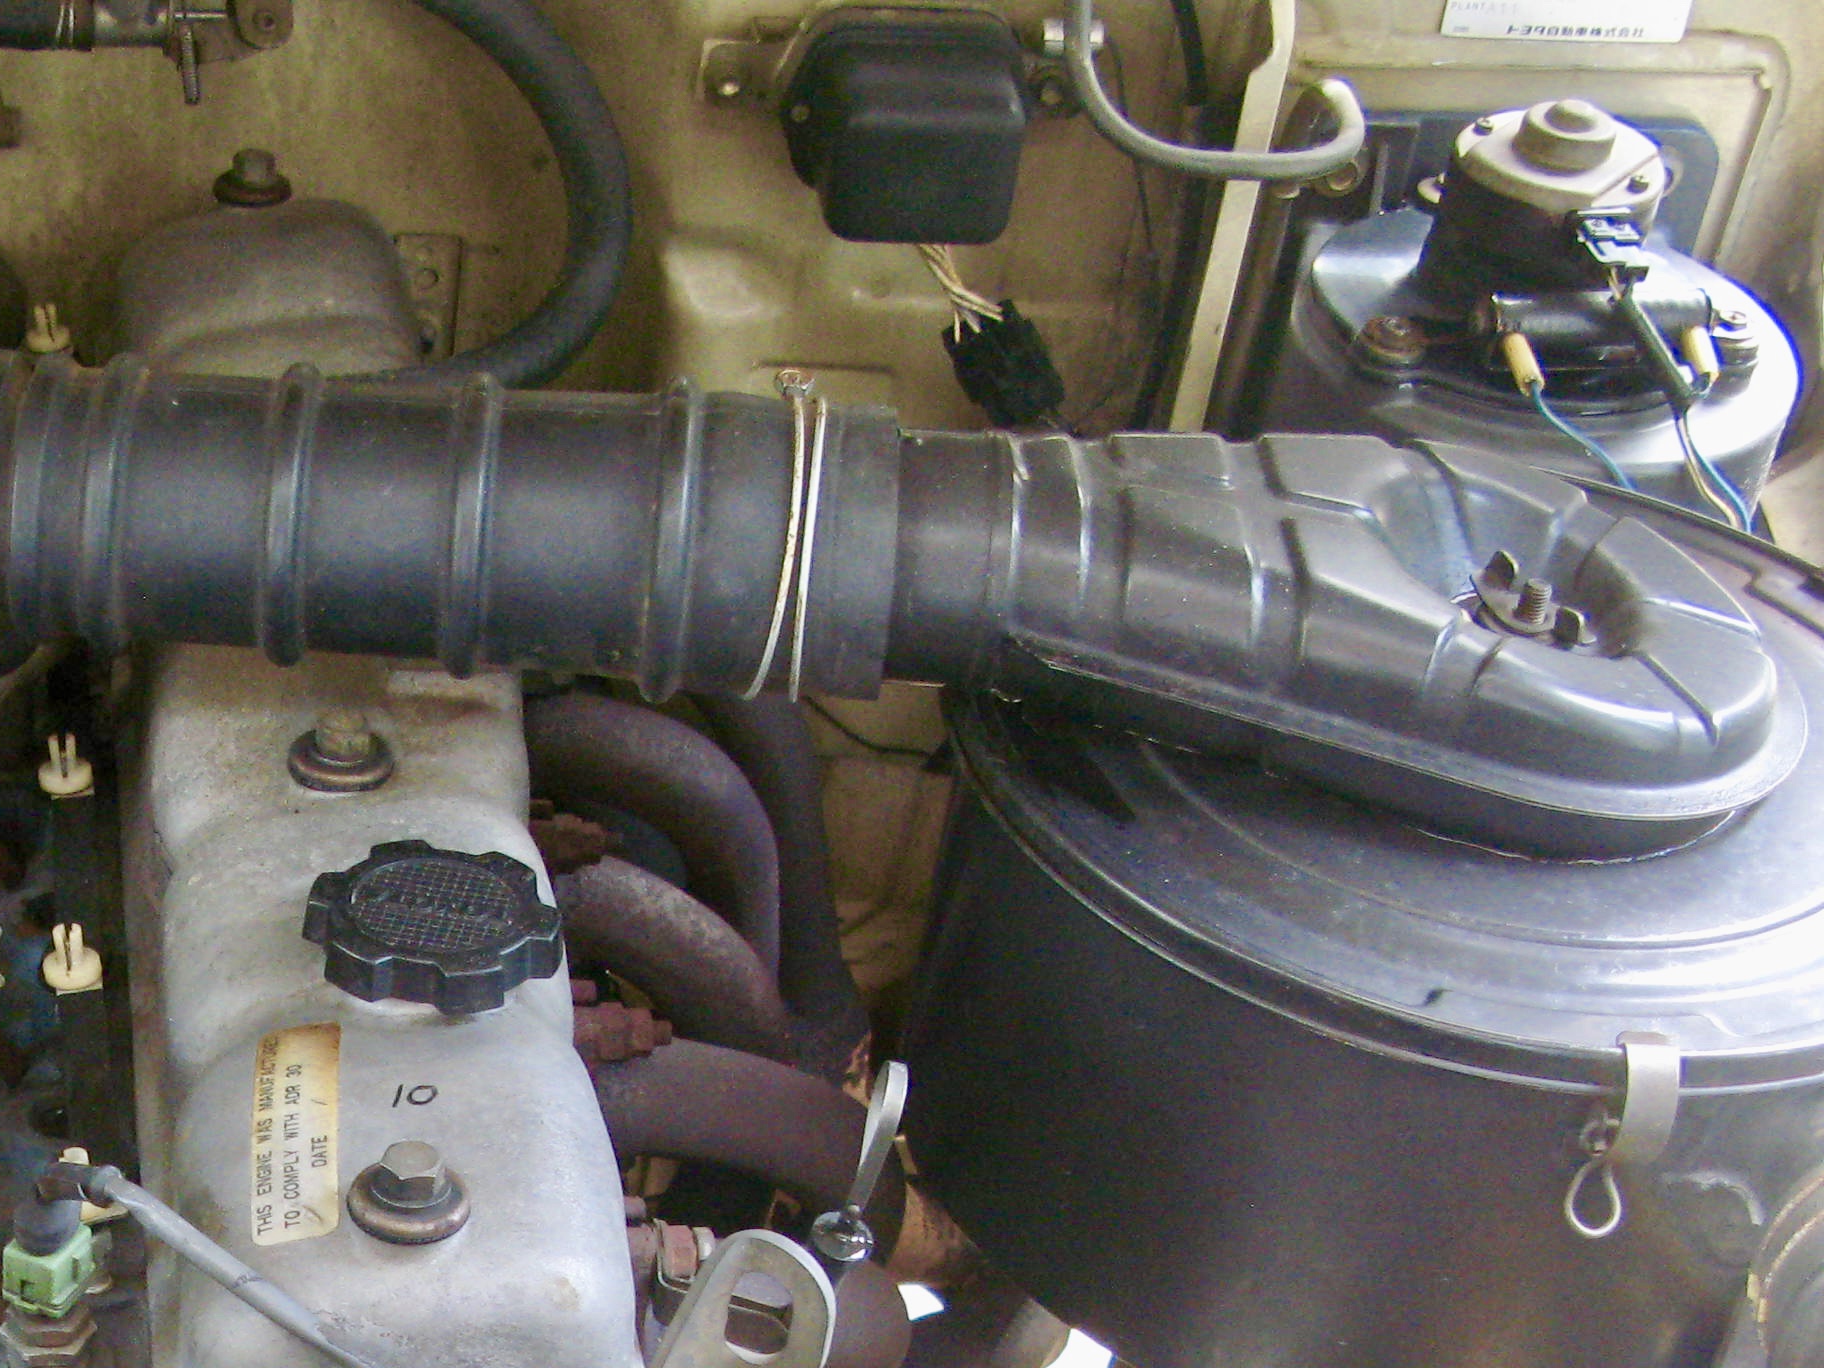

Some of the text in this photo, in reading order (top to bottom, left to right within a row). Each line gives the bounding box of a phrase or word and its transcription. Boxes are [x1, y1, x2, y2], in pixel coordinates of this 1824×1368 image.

[1506, 25, 1645, 38] トヨタ自動車株式会社
[392, 1084, 439, 1108] 10
[257, 1117, 273, 1145] WAS
[284, 1064, 303, 1229] TO COMPLY WITH ADR 30
[311, 1135, 328, 1168] DATE
[257, 1150, 272, 1196] ENGINE
[257, 1204, 272, 1236] THIS
